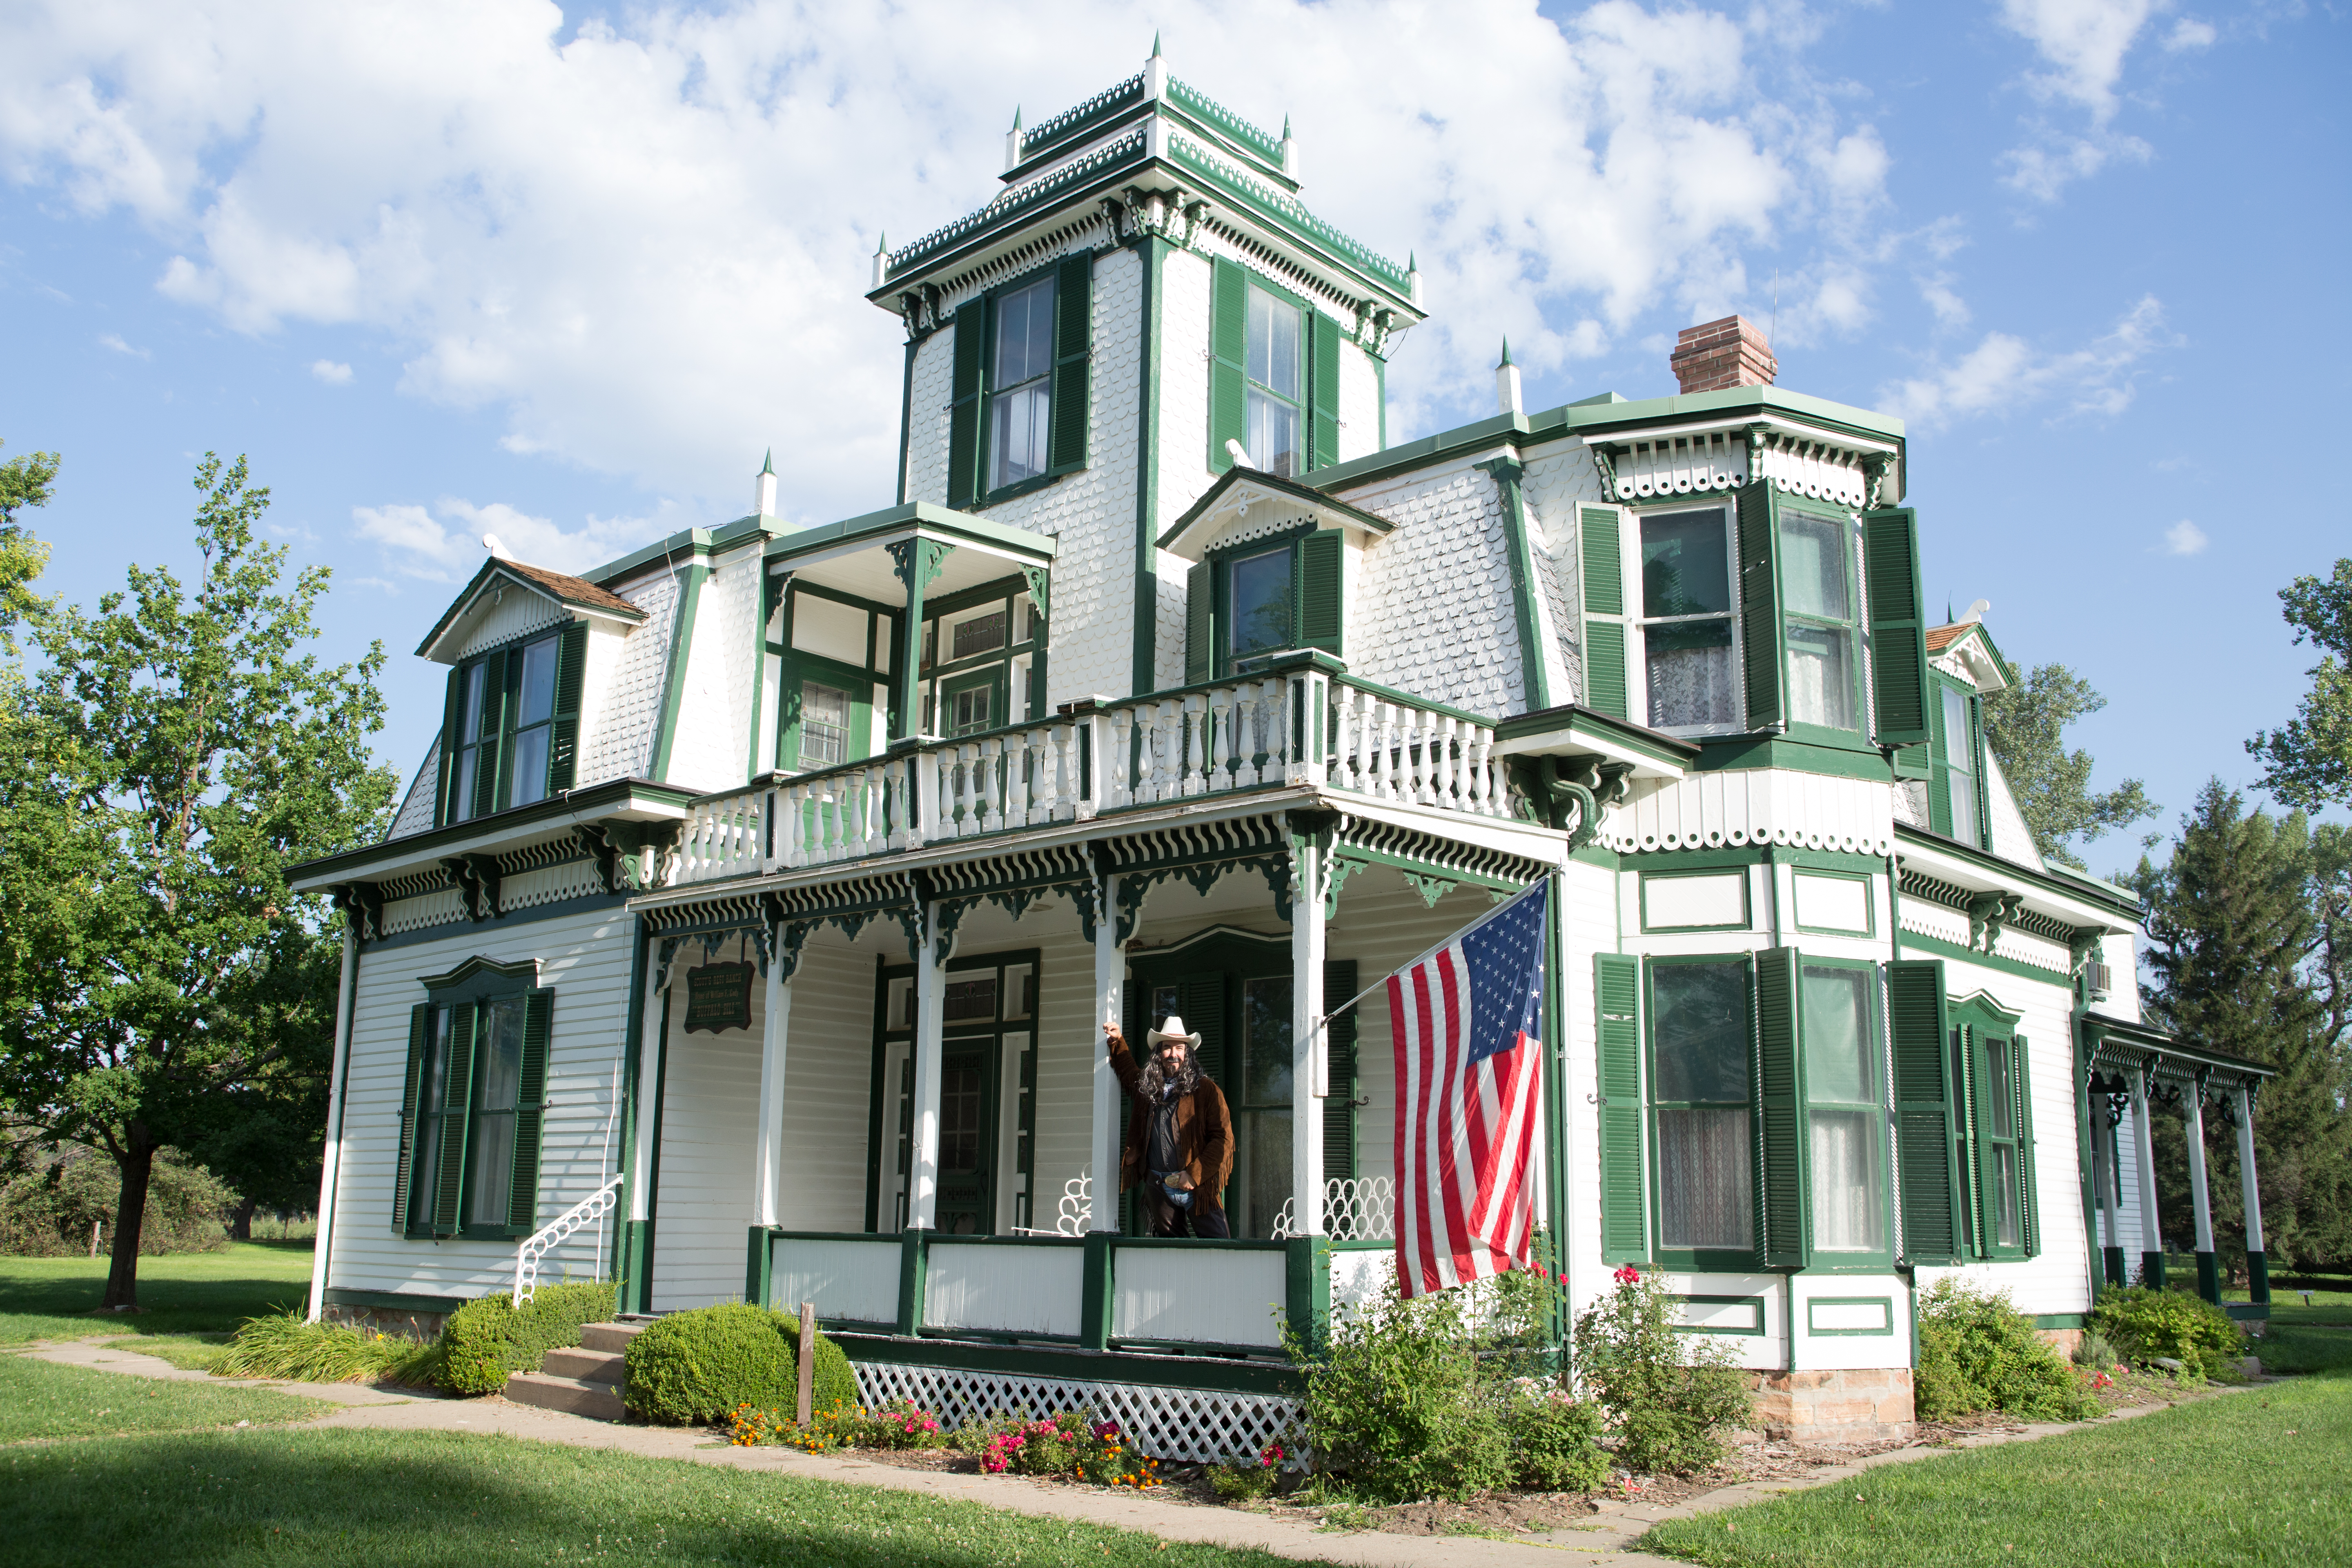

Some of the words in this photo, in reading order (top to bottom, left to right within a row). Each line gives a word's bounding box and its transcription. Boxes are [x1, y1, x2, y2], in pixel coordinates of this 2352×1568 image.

[694, 976, 711, 987] SCOUT'S
[713, 975, 724, 984] REST
[726, 973, 742, 983] RANCH
[706, 991, 710, 999] of
[710, 990, 724, 999] William
[729, 988, 739, 998] Cody
